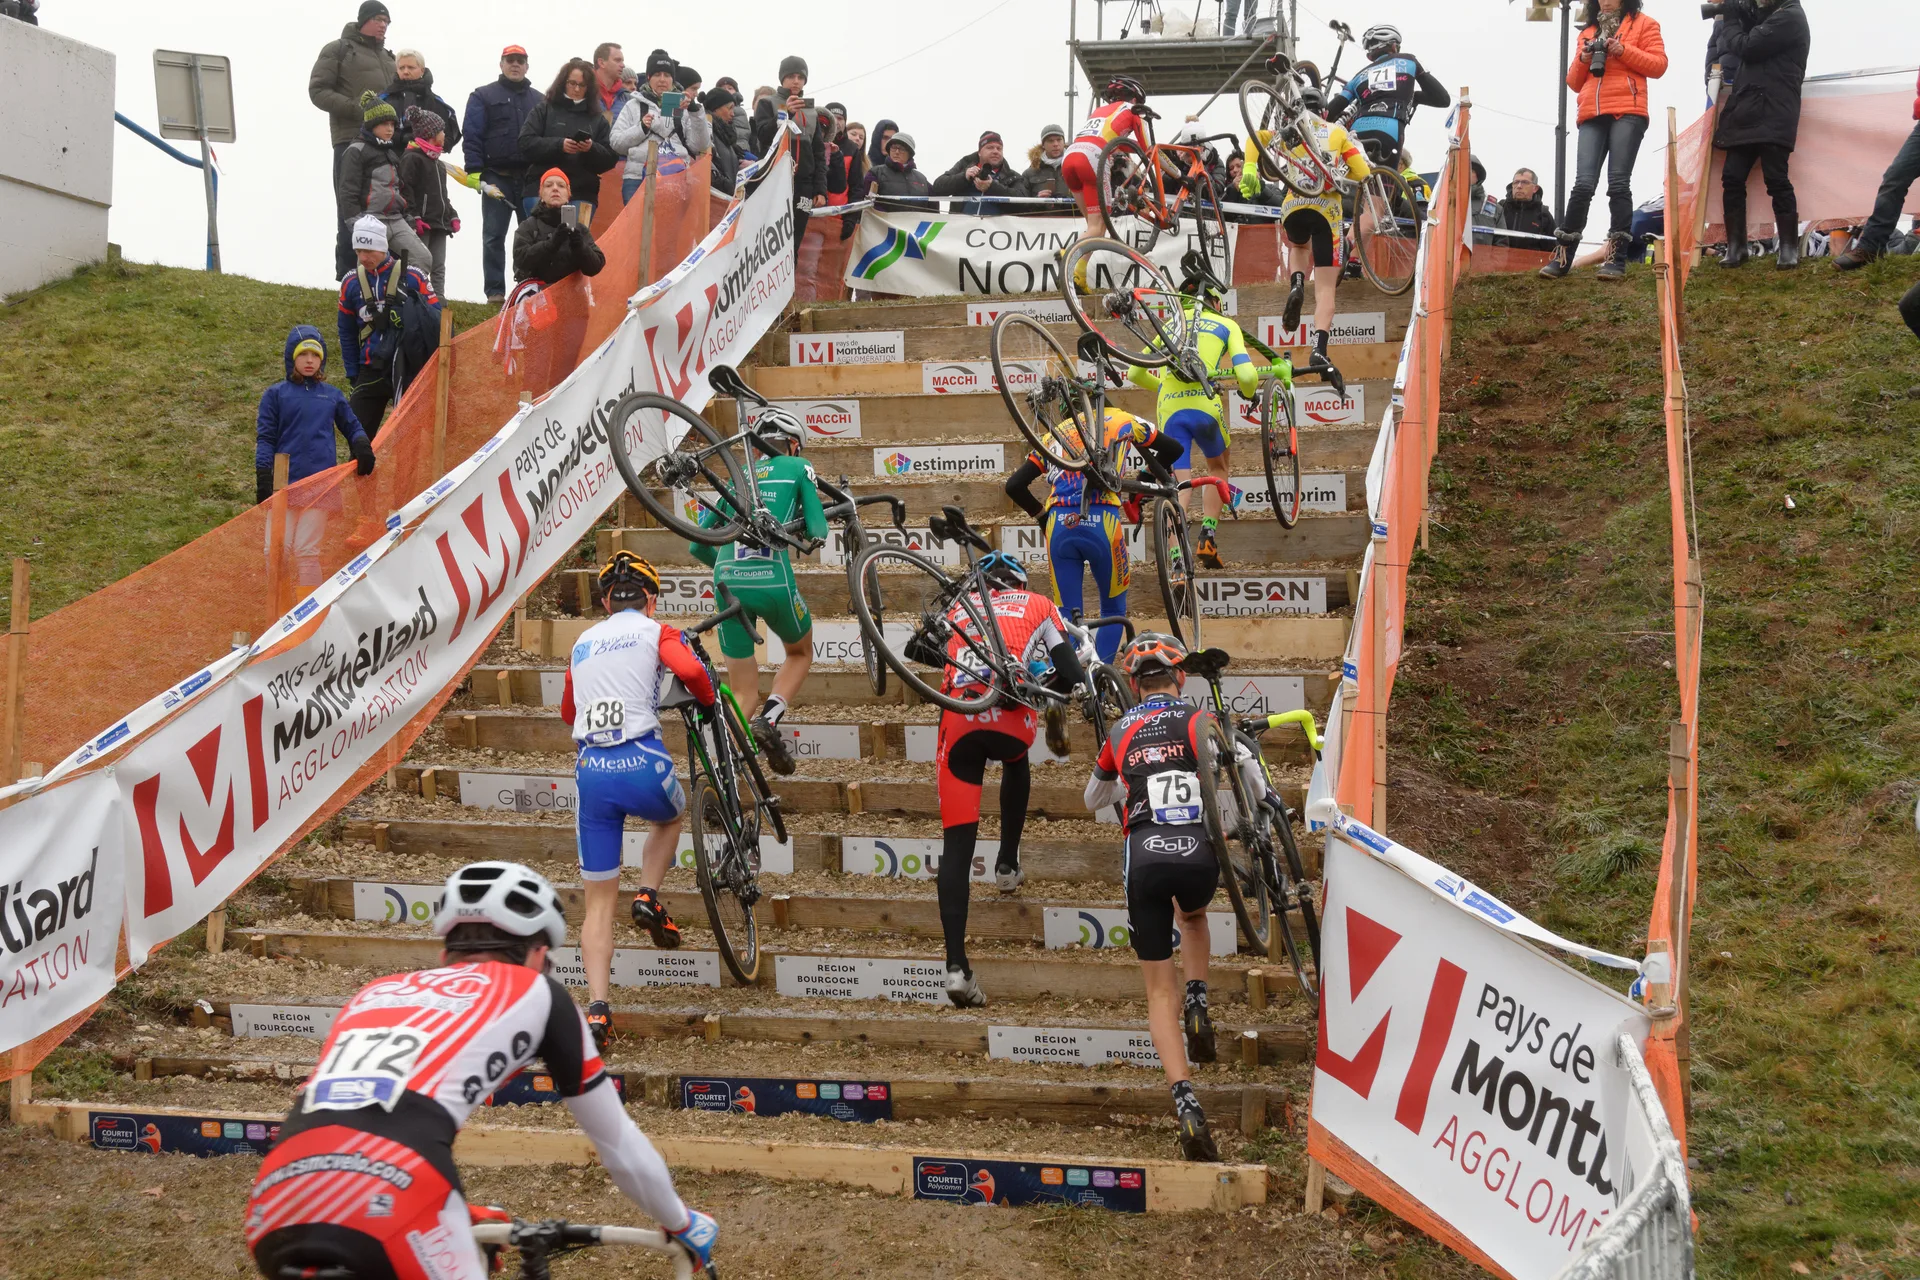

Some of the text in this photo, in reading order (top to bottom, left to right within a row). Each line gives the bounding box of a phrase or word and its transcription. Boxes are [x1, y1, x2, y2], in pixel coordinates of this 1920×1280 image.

[1372, 68, 1389, 82] 71
[1310, 325, 1376, 338] Mntbéliard
[836, 343, 896, 355] Montbéliard
[932, 375, 978, 387] MACCHI
[1304, 399, 1355, 412] MACCHI
[806, 413, 852, 424] MACCHI
[515, 417, 566, 481] Pays de
[913, 455, 996, 473] estimprim
[733, 568, 774, 578] Groupama
[267, 640, 335, 710] Pays de
[273, 584, 438, 765] Montbéliard
[586, 700, 624, 731] 138
[278, 644, 430, 810] AGGLOMÉRATION
[588, 753, 648, 771] Meaux
[1156, 773, 1192, 805] 75
[498, 788, 532, 807] Gris
[638, 968, 700, 979] BOURGOGNE
[797, 975, 946, 989] BOURGOGNE BOURGOGNE
[805, 987, 938, 1000] FRANCHE FRANCHE
[253, 1023, 315, 1034] BOURGOGNE
[1476, 982, 1595, 1084] Pays de
[328, 1031, 421, 1077] 172
[1012, 1046, 1081, 1057] BOURGOGNE
[694, 1093, 727, 1102] COURTET
[102, 1129, 134, 1138] COURTET
[102, 1136, 134, 1145] Polycomm
[927, 1175, 963, 1185] COURTET
[927, 1182, 963, 1192] Polycomm
